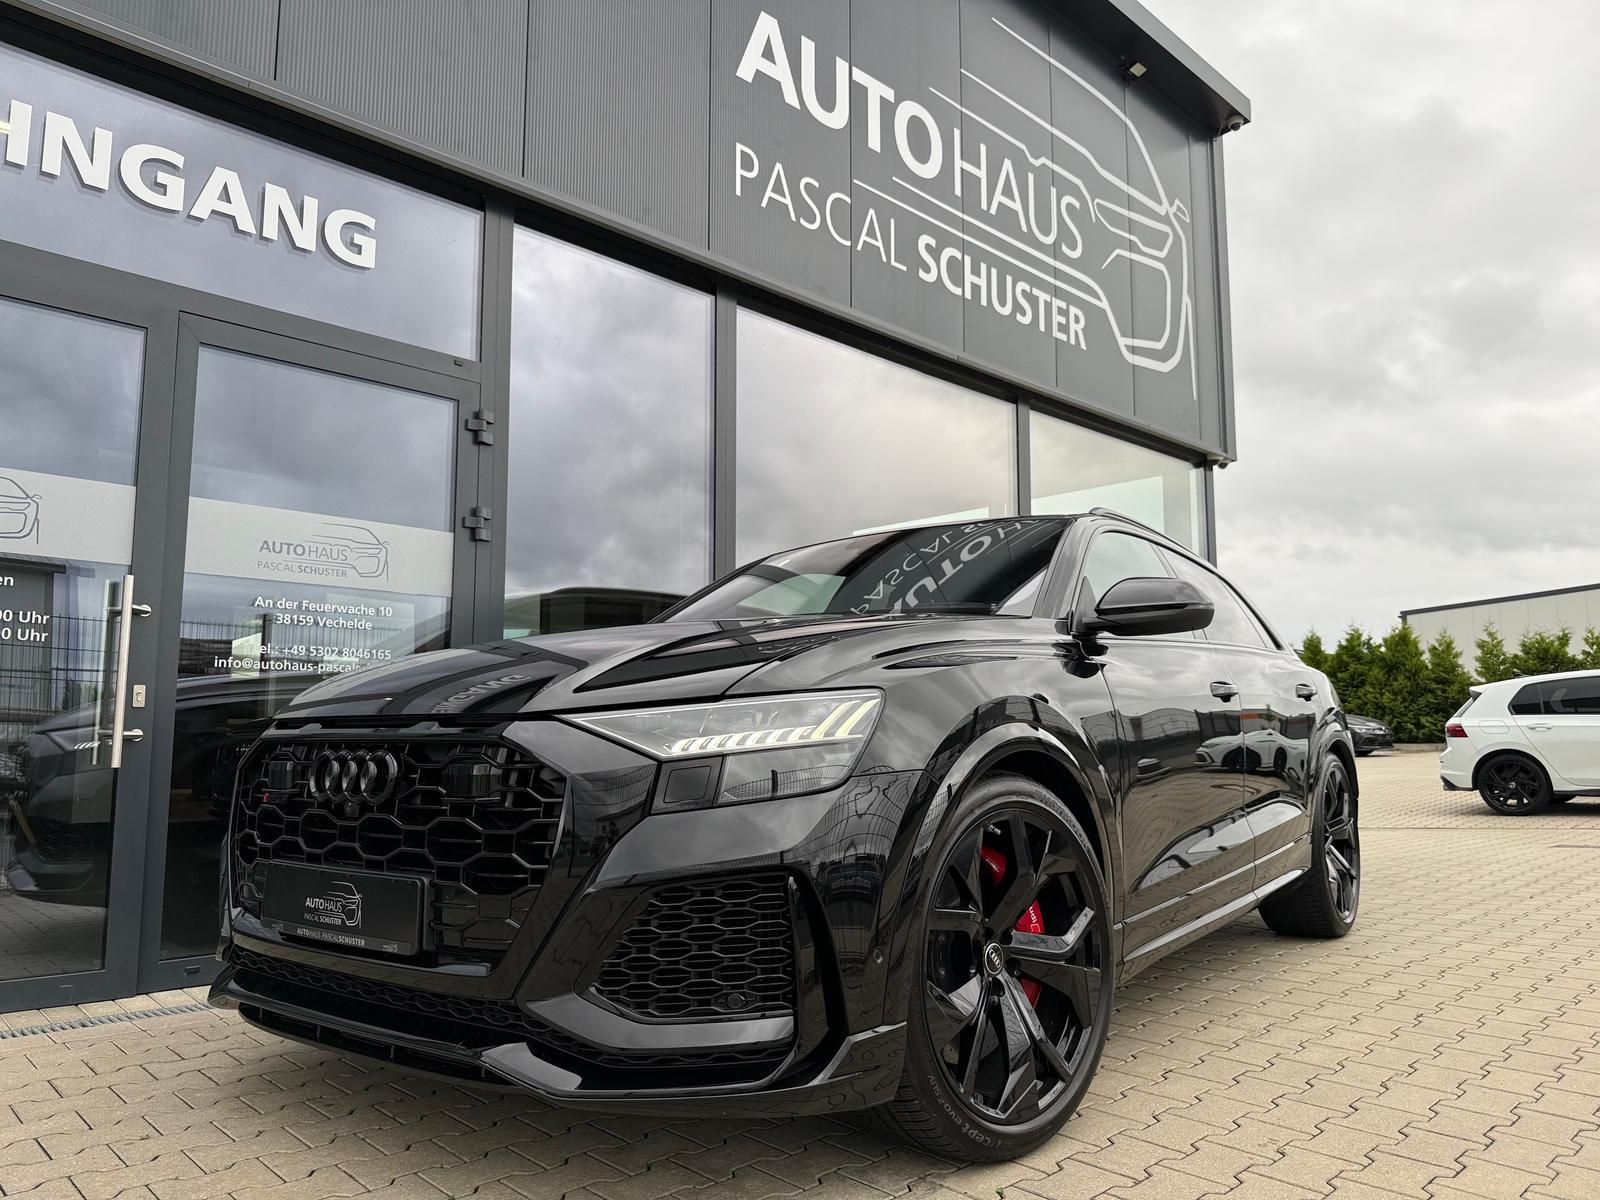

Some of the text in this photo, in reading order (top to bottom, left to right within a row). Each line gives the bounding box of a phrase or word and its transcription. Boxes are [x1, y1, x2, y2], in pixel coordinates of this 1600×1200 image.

[735, 142, 1087, 351] PASCAL SCHUSTER
[257, 560, 348, 578] PASCAL SCHUSTER
[254, 596, 393, 617] An der Feuerwache 10
[18, 610, 50, 624] Uhr
[275, 613, 373, 630] 38159 Vechelde
[17, 628, 49, 642] Uhr
[254, 642, 392, 660] el.: +49 5302 8046165
[303, 912, 342, 926] PASCAL SCHUSTER
